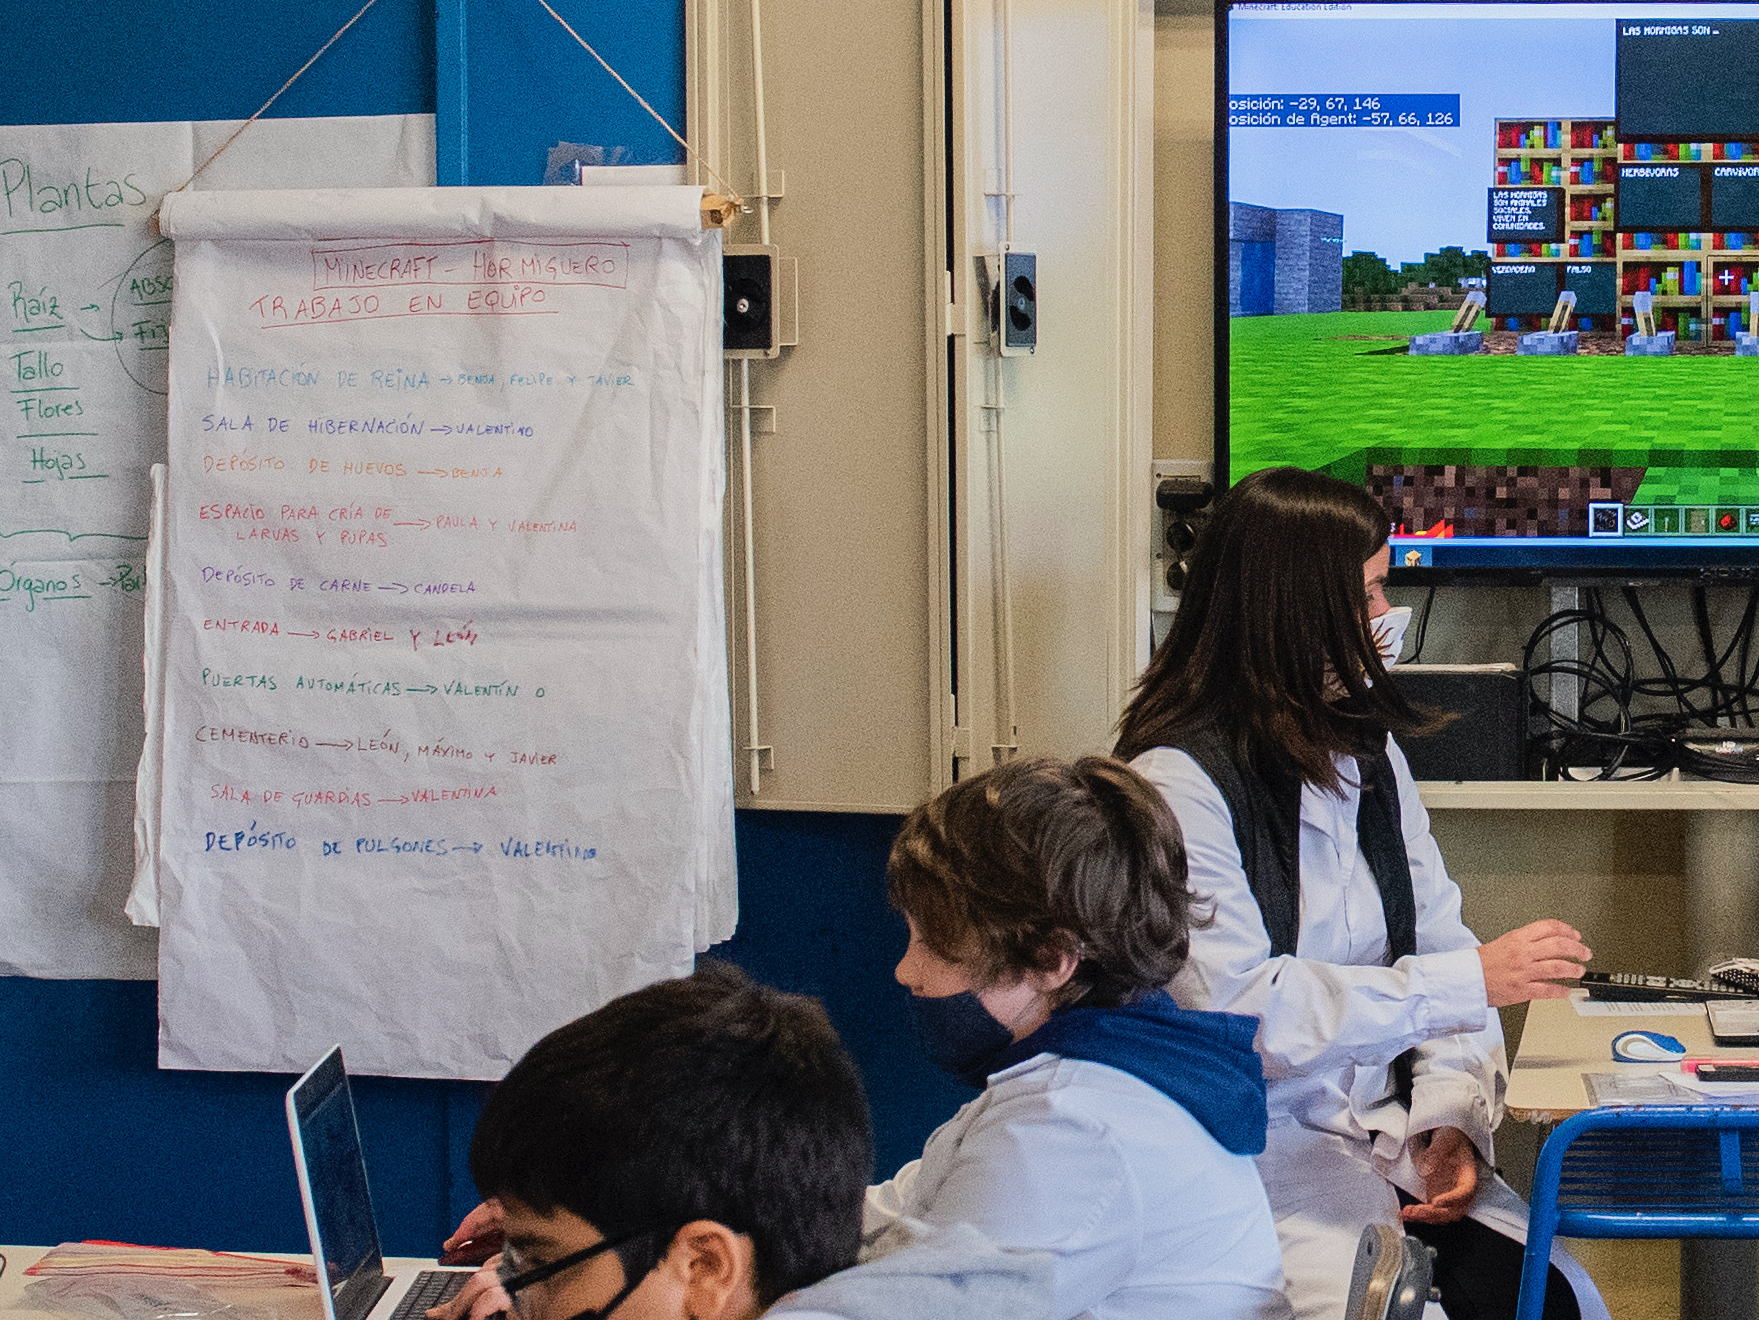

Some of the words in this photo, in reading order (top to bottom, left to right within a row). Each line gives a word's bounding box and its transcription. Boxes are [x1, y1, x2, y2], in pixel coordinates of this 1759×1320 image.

[1691, 25, 1711, 35] SON
[1289, 97, 1320, 111] -29,
[1325, 97, 1348, 112] 67,
[1353, 97, 1381, 110] 146
[1287, 113, 1305, 125] de
[1310, 113, 1357, 127] Agent:
[1362, 113, 1393, 127] -57,
[1398, 113, 1421, 127] 66,
[1426, 113, 1454, 125] 126
[324, 253, 440, 282] MINECRAFT
[249, 293, 379, 321] TRABAJO
[409, 293, 443, 313] EN
[468, 285, 546, 311] EQUIPO
[10, 351, 64, 380] Tallo
[337, 370, 357, 388] DE
[17, 398, 83, 420] Flores
[202, 413, 253, 433] SALA
[268, 417, 289, 433] DE
[30, 447, 86, 476] Hojas
[309, 458, 330, 473] DE
[343, 461, 406, 477] HUEVOS
[199, 504, 265, 521] ESPACIO
[281, 505, 319, 521] PARA
[329, 502, 363, 520] CRÍA
[374, 506, 392, 519] DE
[436, 515, 478, 530] PAULA
[488, 520, 497, 531] Y
[236, 526, 299, 543] LARVAS
[341, 531, 388, 548] PUPAS
[290, 578, 304, 591] DE
[319, 579, 372, 592] CARNE
[414, 582, 476, 594] CANDELA
[203, 619, 280, 636] ENTRADA
[410, 628, 419, 651] Y
[202, 667, 277, 690] PUERTAS
[211, 784, 251, 805] SALA
[263, 789, 282, 803] DE
[205, 820, 297, 852] DEPÓSITO
[322, 841, 342, 856] DE
[356, 836, 448, 857] PULGONES
